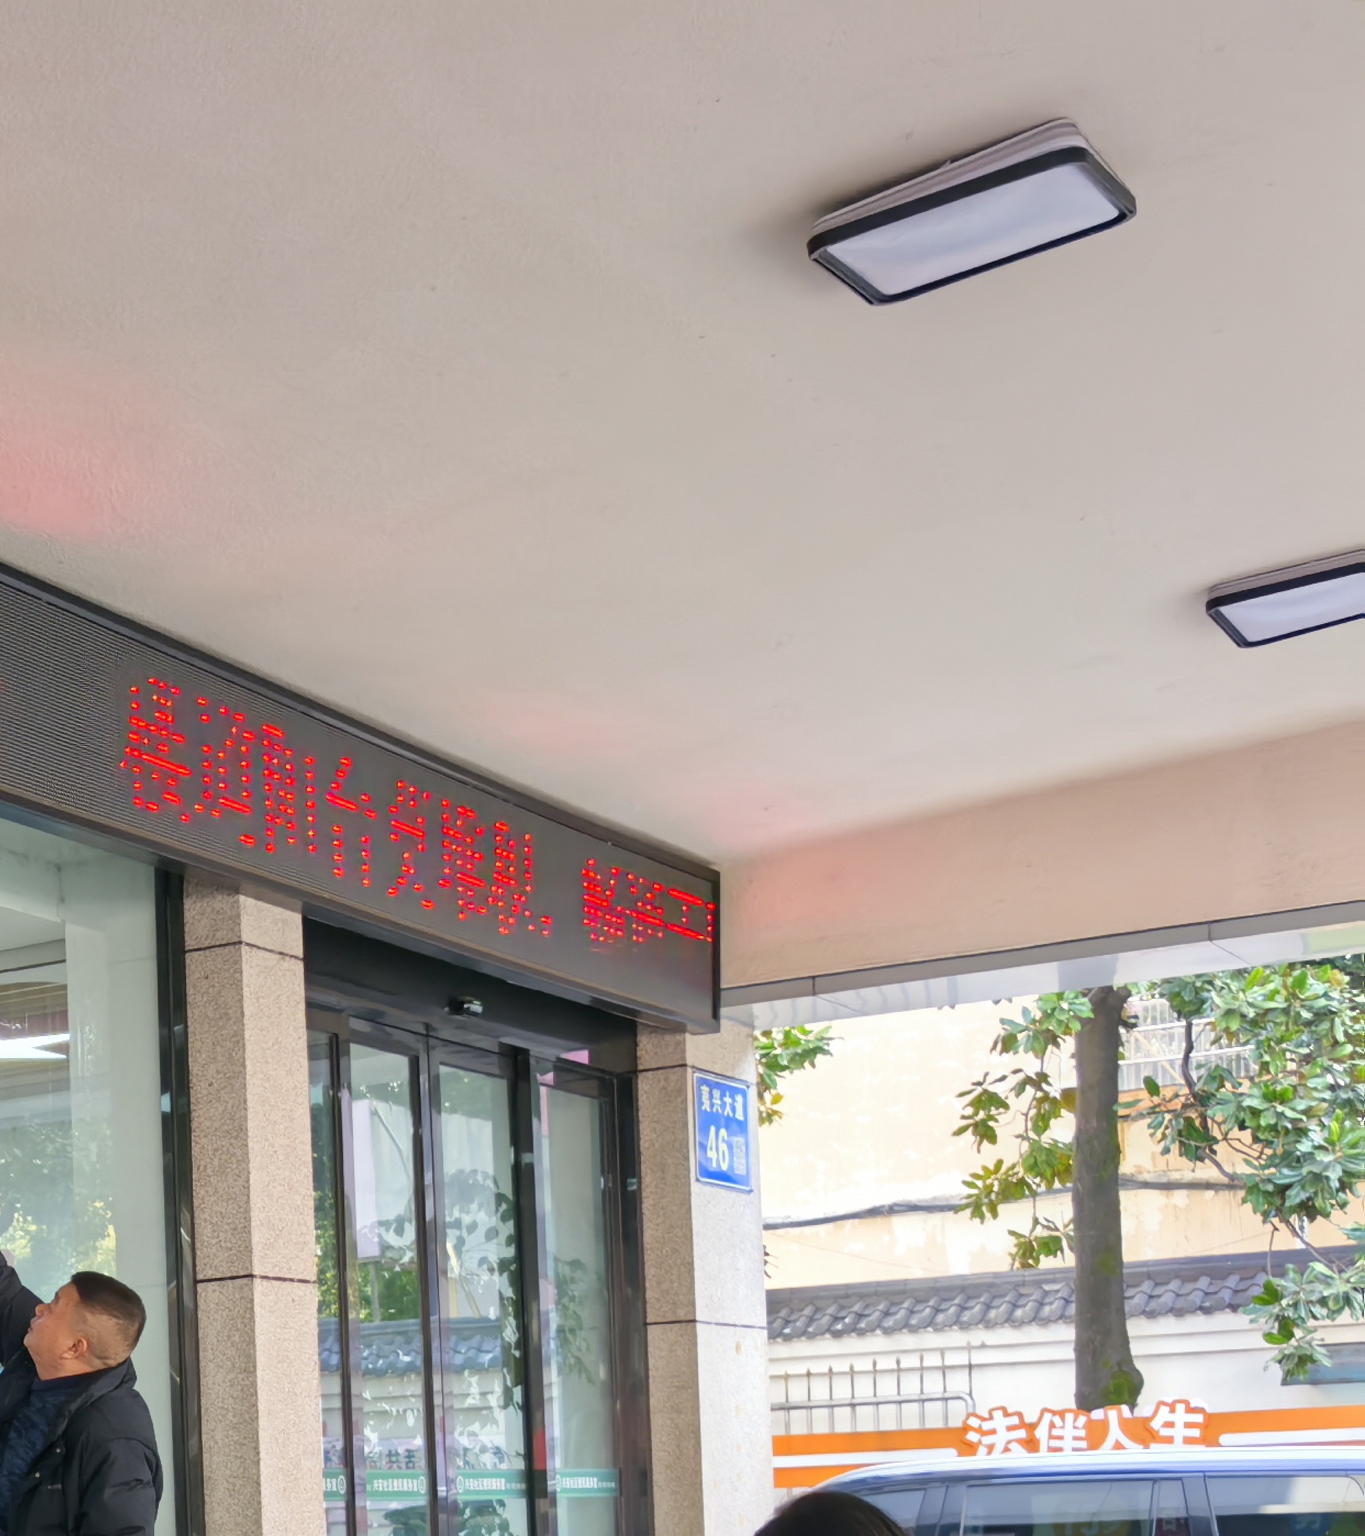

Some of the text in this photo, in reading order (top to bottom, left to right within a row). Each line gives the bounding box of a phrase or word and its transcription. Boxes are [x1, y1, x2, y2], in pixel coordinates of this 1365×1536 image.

[700, 1084, 744, 1121] 夷兴大道
[707, 1125, 729, 1171] 46
[965, 1403, 1204, 1456] 法伴人生
